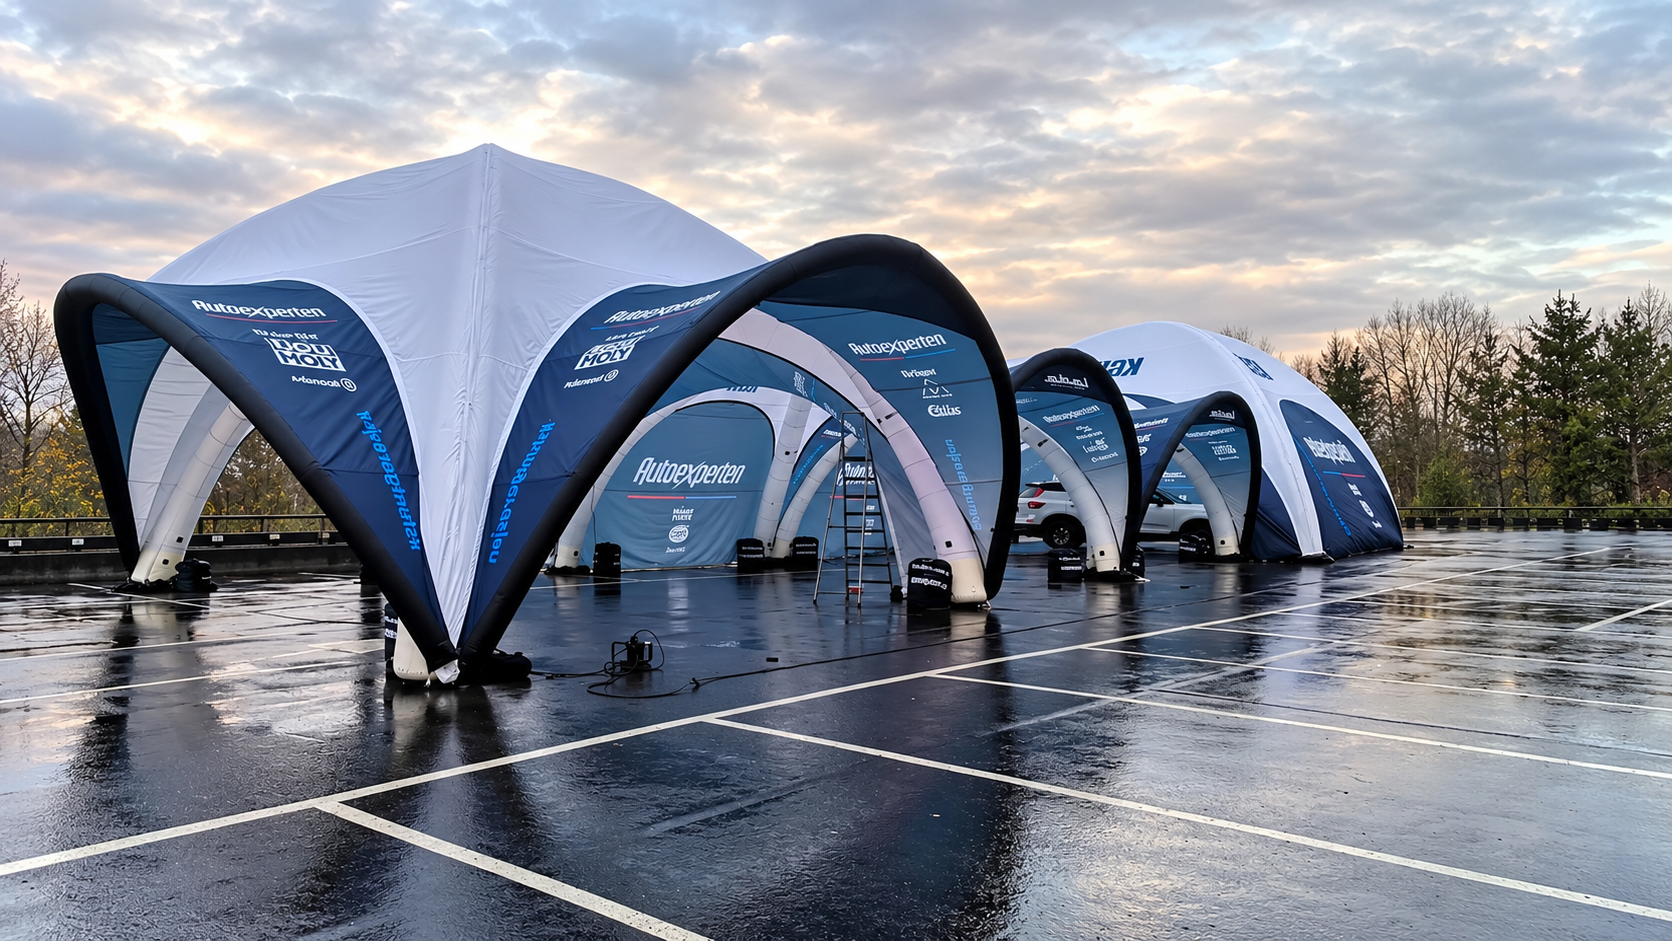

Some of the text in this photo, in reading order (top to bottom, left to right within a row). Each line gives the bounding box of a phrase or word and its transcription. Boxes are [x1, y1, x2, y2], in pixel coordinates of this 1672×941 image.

[192, 300, 326, 319] Autoexperten
[848, 334, 947, 355] Autoexperten
[276, 351, 339, 369] MOLY
[579, 346, 632, 368] MOLY
[632, 457, 746, 490] Autoexperten
